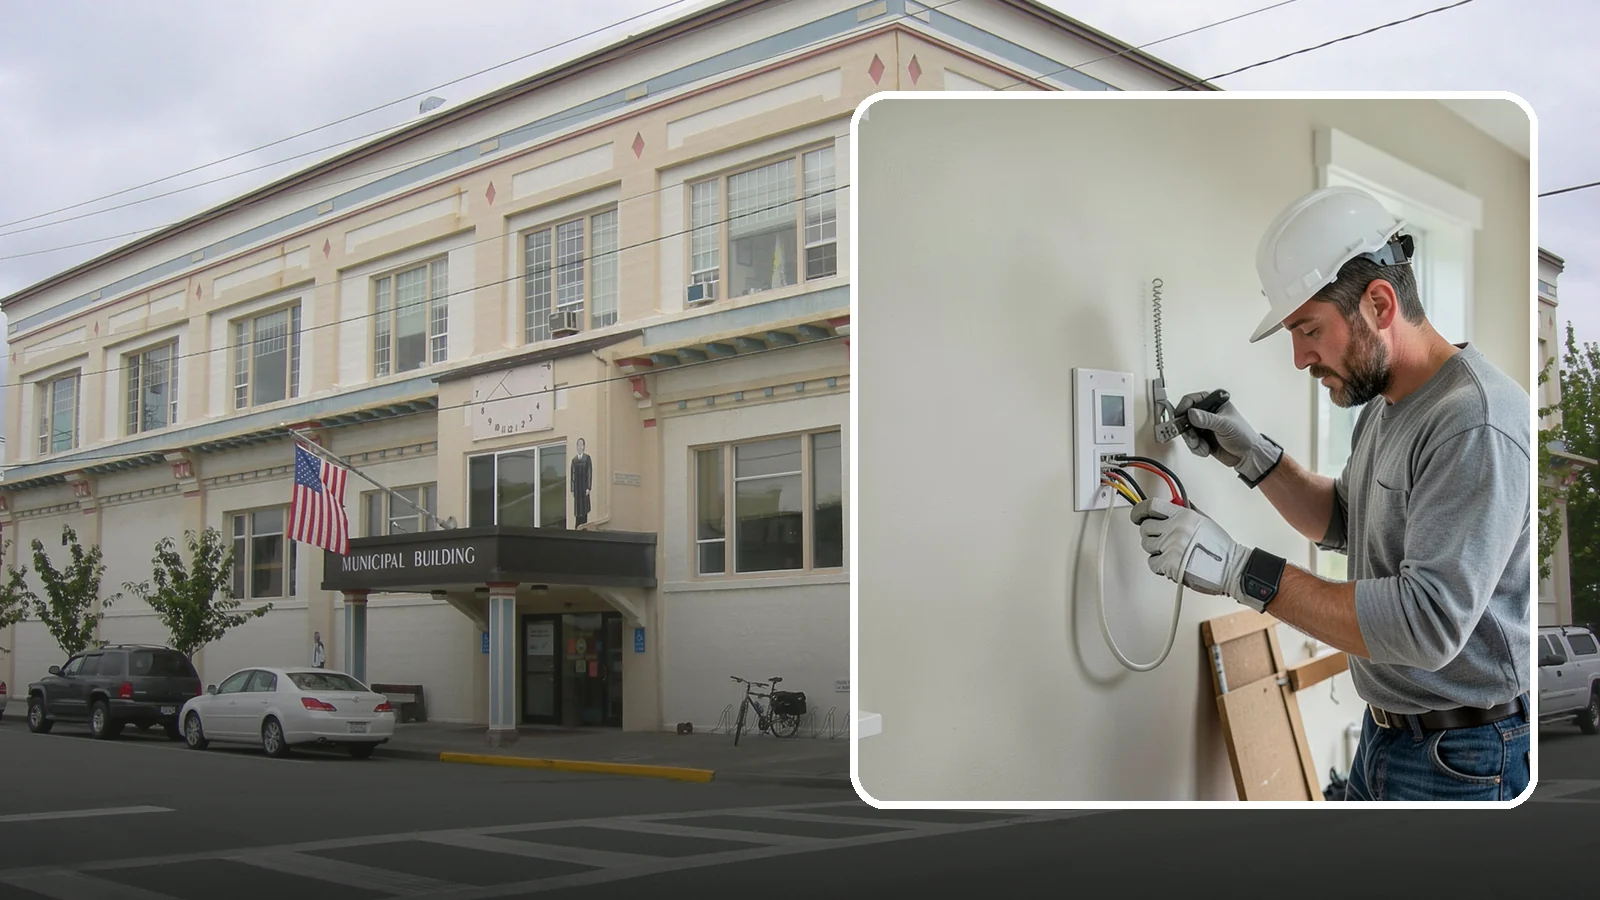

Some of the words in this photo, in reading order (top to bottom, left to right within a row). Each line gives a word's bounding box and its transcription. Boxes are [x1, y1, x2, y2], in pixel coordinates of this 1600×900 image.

[536, 402, 540, 410] 4
[480, 407, 485, 415] 8
[487, 417, 492, 426] 9
[529, 414, 533, 422] 3
[494, 423, 500, 432] 10
[521, 420, 525, 428] 2
[507, 425, 513, 433] 12
[342, 552, 405, 572] MUNICIPAL
[414, 546, 475, 567] BUILDING
